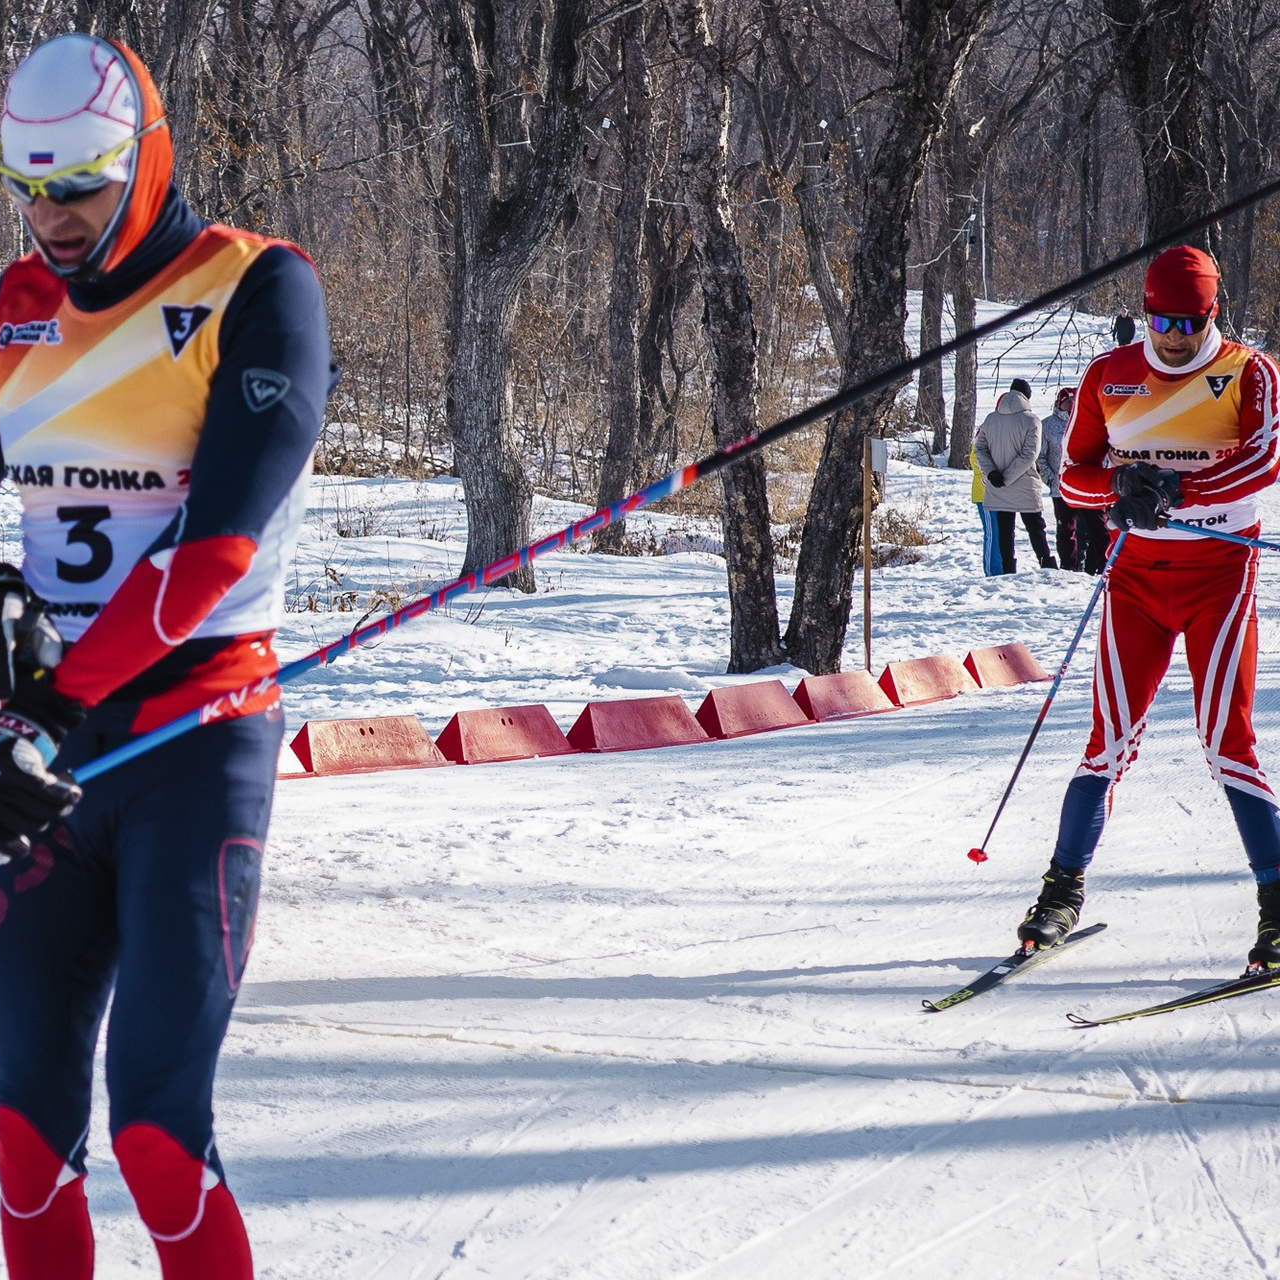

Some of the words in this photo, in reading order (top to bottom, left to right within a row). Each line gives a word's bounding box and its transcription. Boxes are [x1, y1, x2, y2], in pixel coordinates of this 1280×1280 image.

[173, 311, 194, 340] 3
[1213, 377, 1225, 391] 3
[1155, 450, 1210, 460] ГОНКА
[63, 466, 166, 491] ГОНКА
[55, 505, 113, 584] 3
